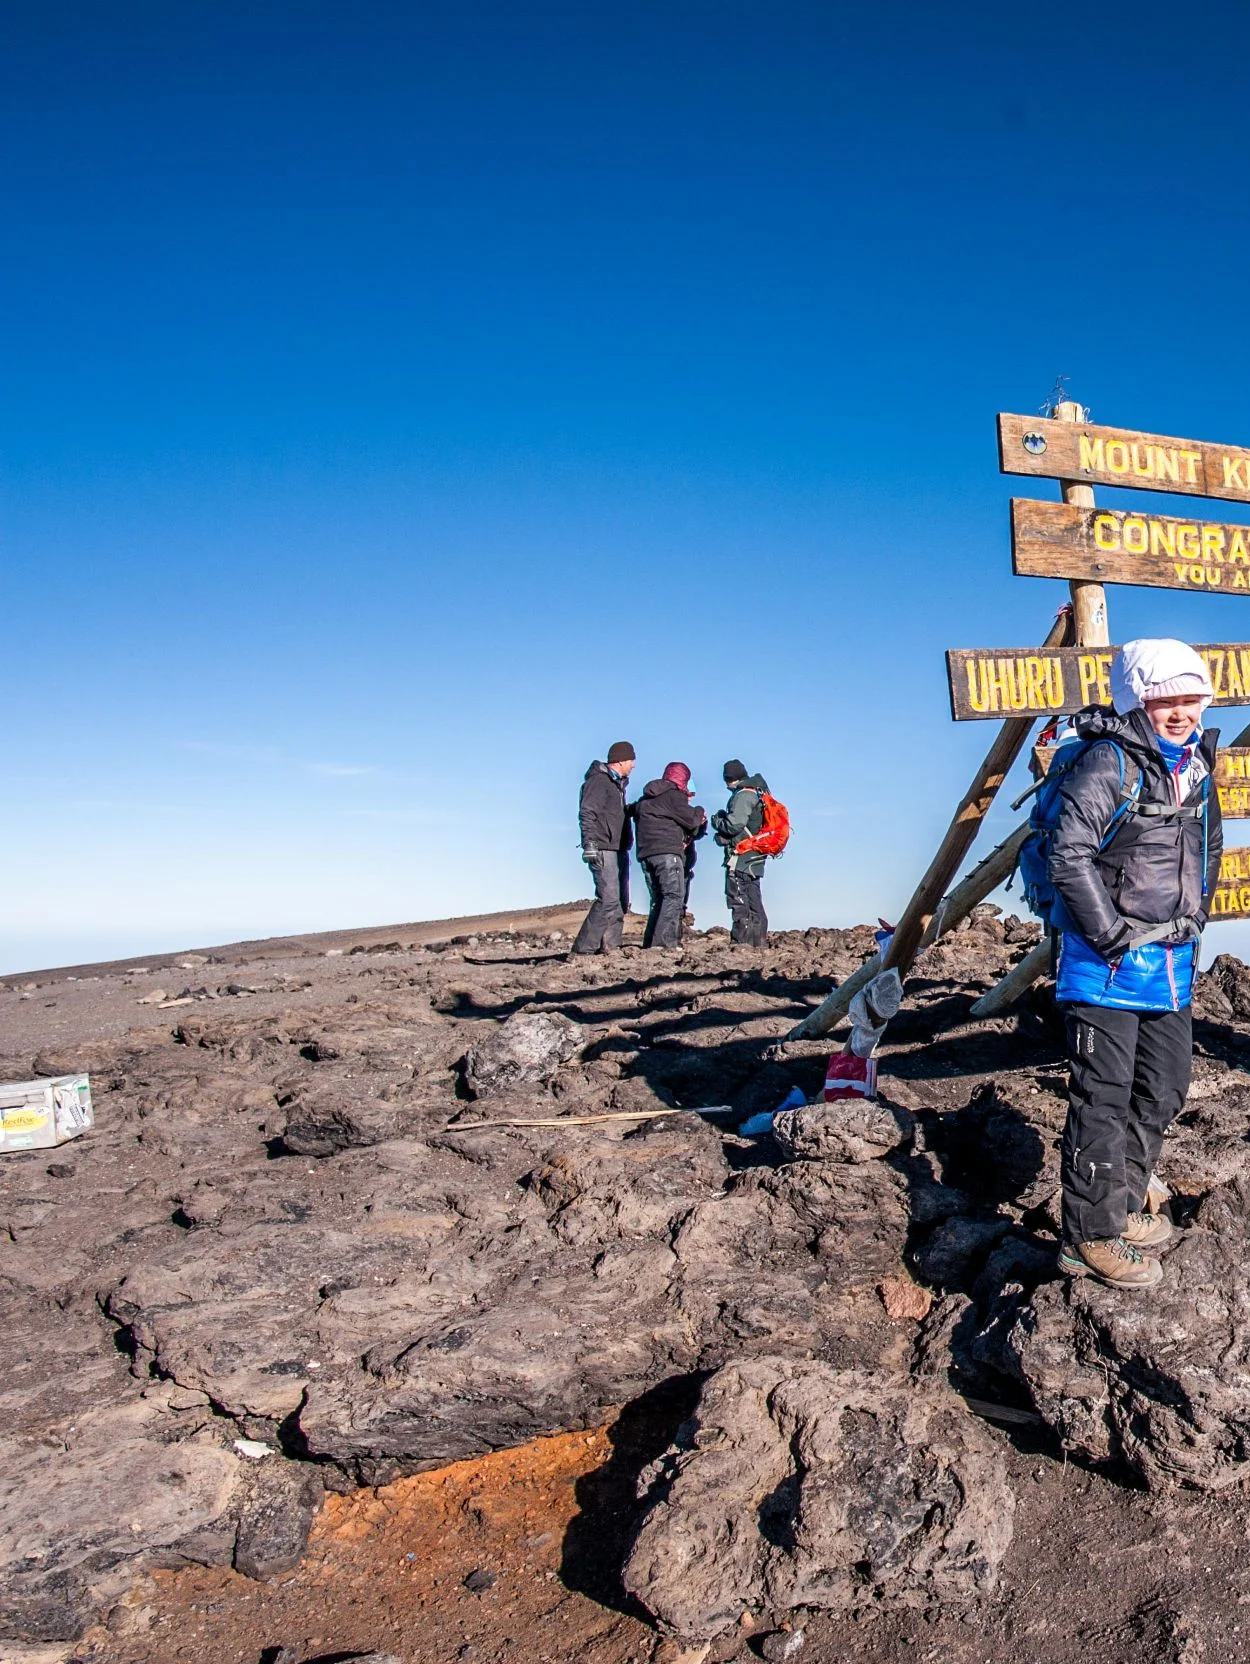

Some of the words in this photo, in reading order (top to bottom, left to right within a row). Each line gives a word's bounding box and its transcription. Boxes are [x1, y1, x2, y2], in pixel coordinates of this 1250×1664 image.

[1079, 435, 1202, 484] MOUNT
[1174, 563, 1222, 586] YOU
[966, 656, 1065, 712] UHURU
[1077, 655, 1114, 707] PE
[1217, 787, 1250, 810] EST
